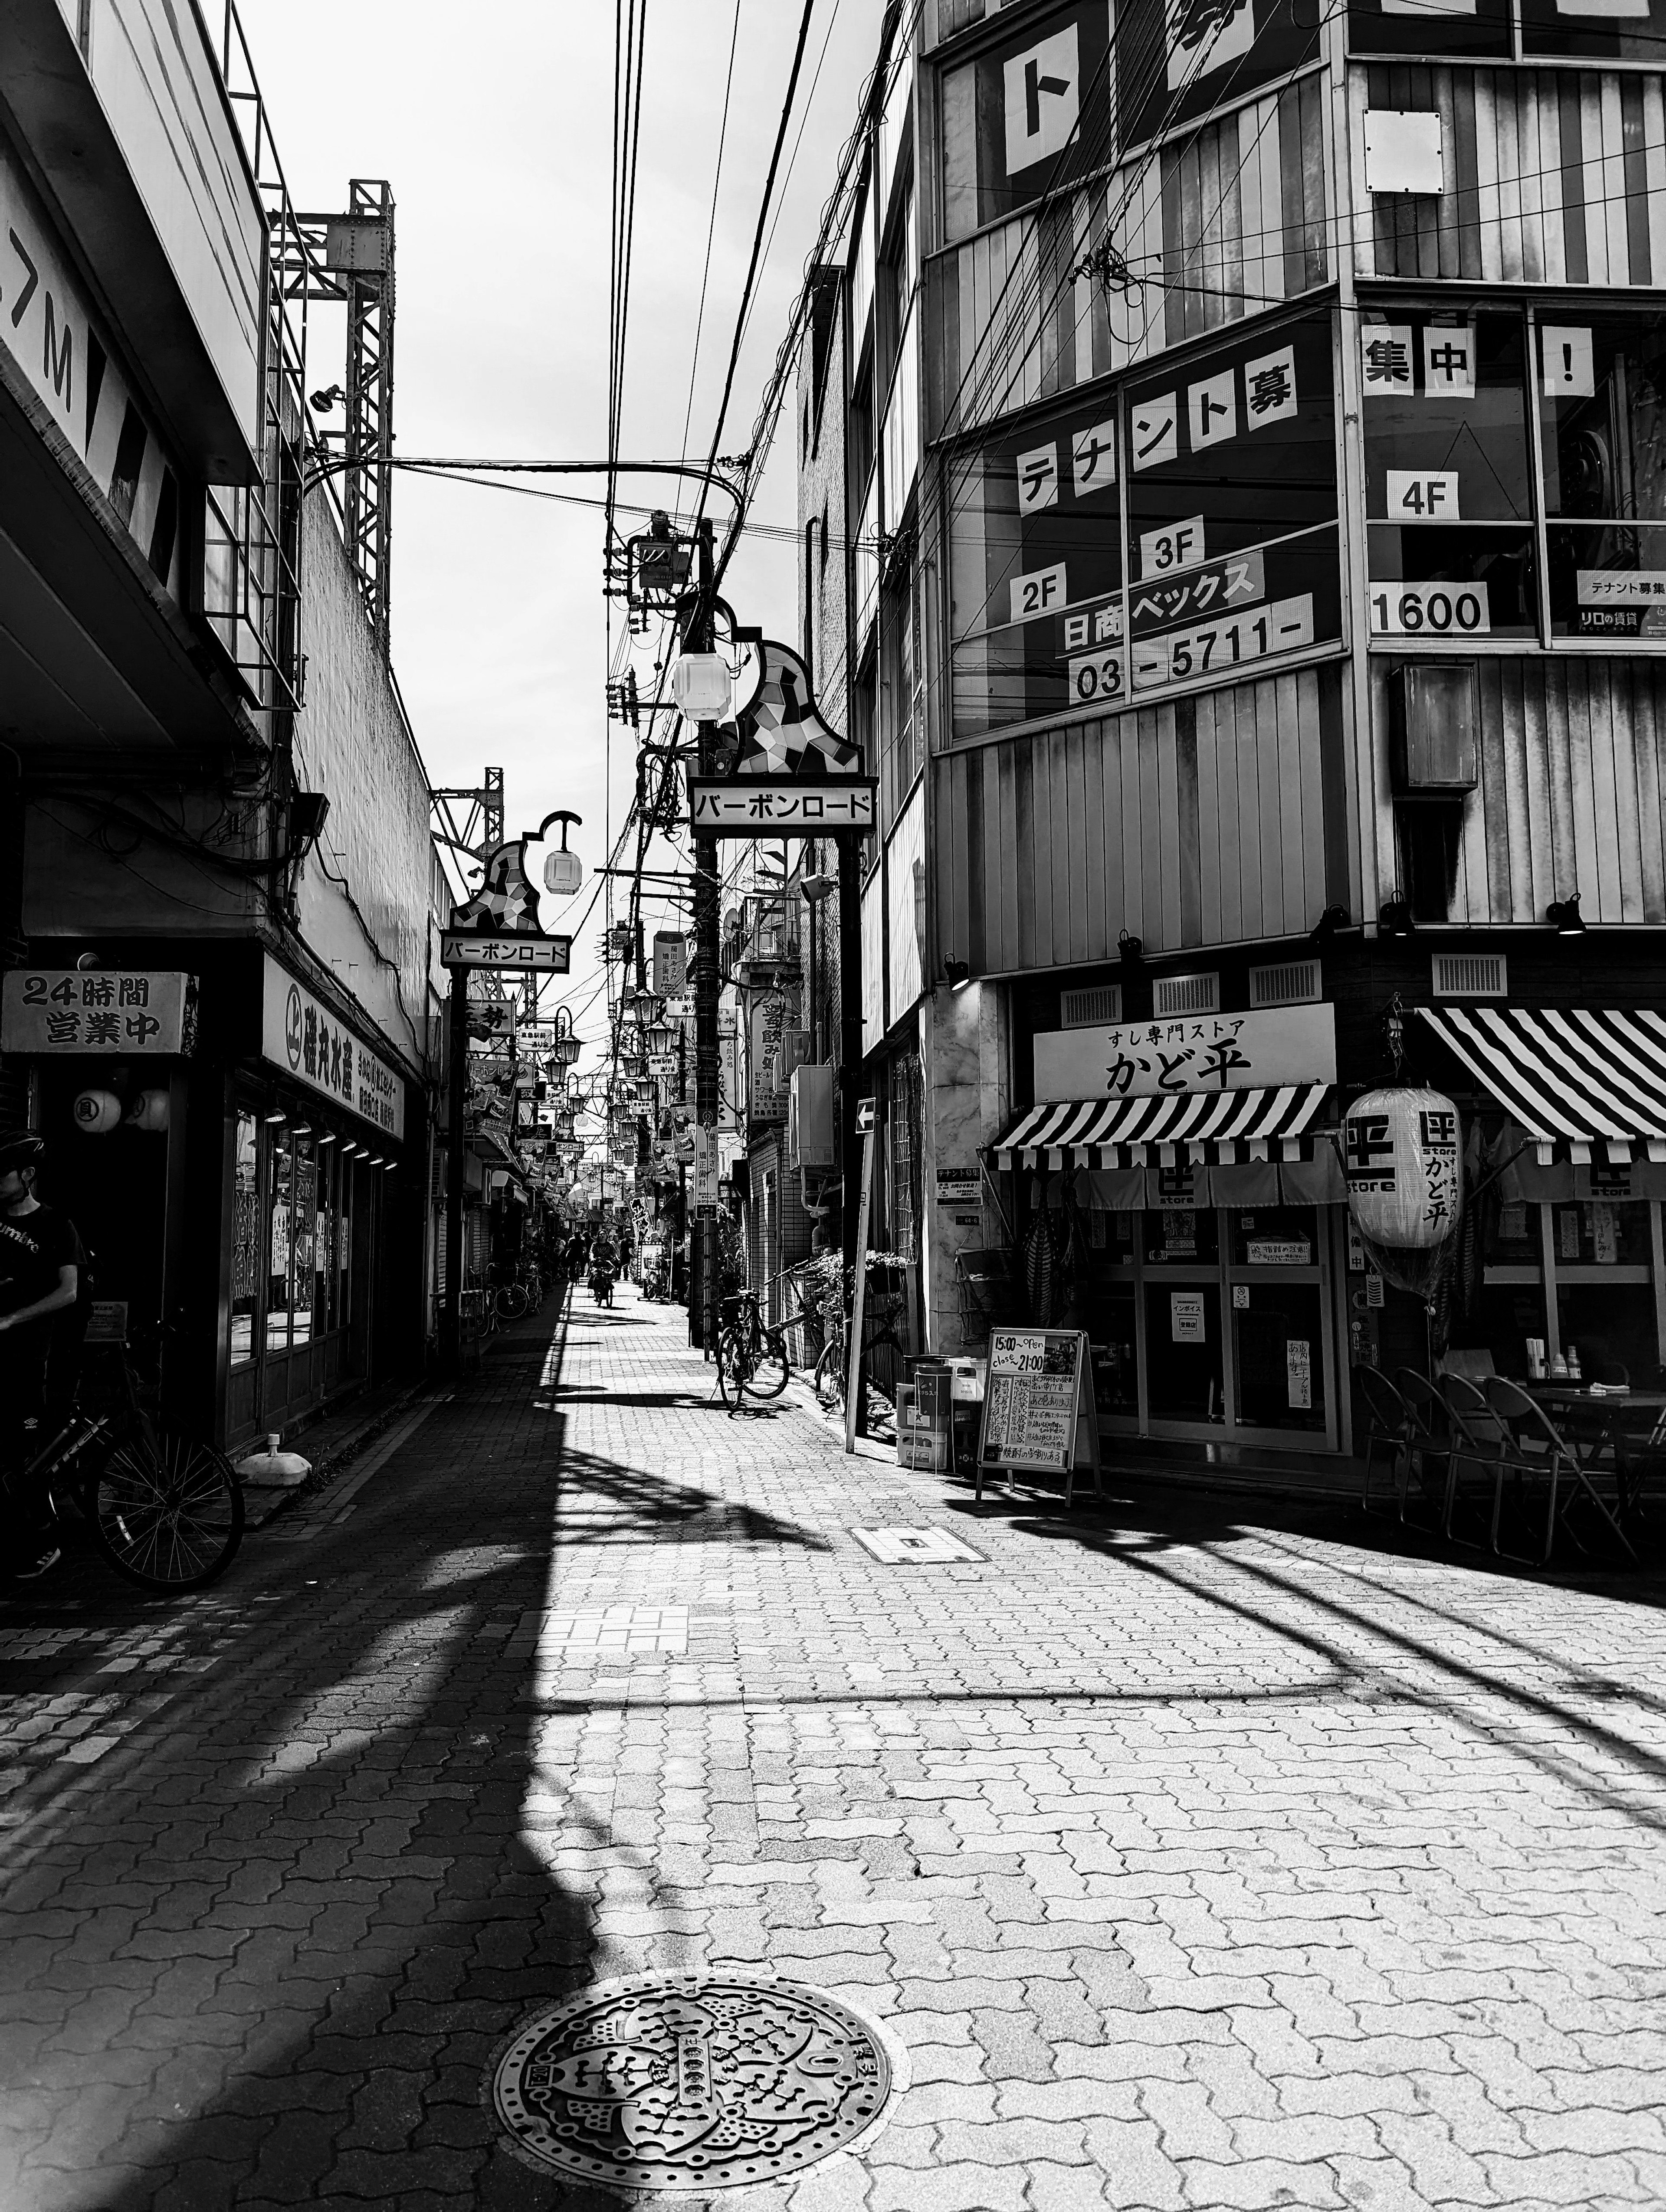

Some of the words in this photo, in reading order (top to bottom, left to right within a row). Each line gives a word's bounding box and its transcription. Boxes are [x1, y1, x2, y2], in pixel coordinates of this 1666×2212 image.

[1026, 59, 1068, 137] ト
[1022, 363, 1292, 503] テナント募
[1402, 481, 1446, 515] 4F
[1154, 527, 1194, 569] 3F
[1022, 574, 1057, 613] 2F
[1592, 582, 1666, 595] テナント募集
[1373, 592, 1480, 630] 1600
[1581, 612, 1637, 625] リロの賃貸
[695, 794, 870, 819] バーボンロード
[445, 942, 566, 963] バーボンロード
[22, 976, 150, 1008] 24時間
[45, 1011, 160, 1045] 営業中
[1108, 1020, 1246, 1048] すし専門ストア
[1105, 1037, 1252, 1094] かど平
[1423, 1147, 1457, 1155] store
[938, 1168, 979, 1177] テナント募集
[1422, 1157, 1450, 1231] かど平
